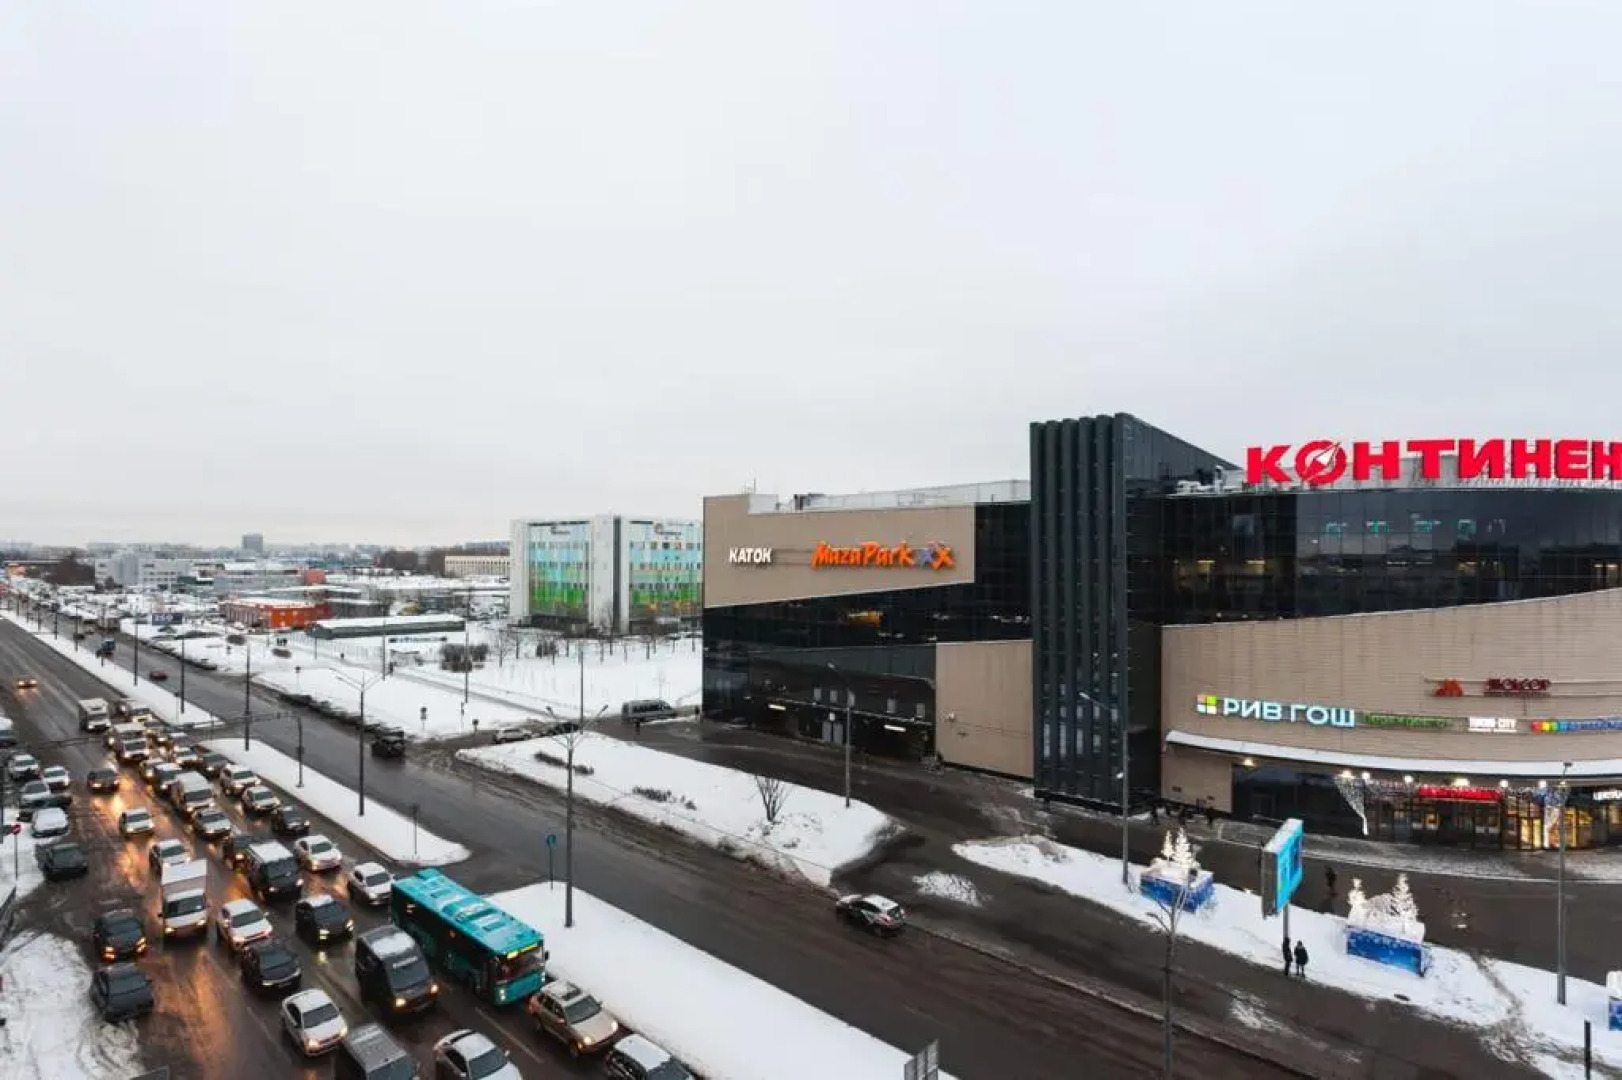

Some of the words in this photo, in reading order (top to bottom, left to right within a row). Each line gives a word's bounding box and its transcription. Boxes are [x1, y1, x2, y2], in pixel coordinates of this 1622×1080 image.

[728, 547, 772, 563] КАТОК
[811, 540, 914, 569] MazaPark
[1223, 697, 1282, 721] РИВ
[1290, 704, 1355, 728] ГОШ
